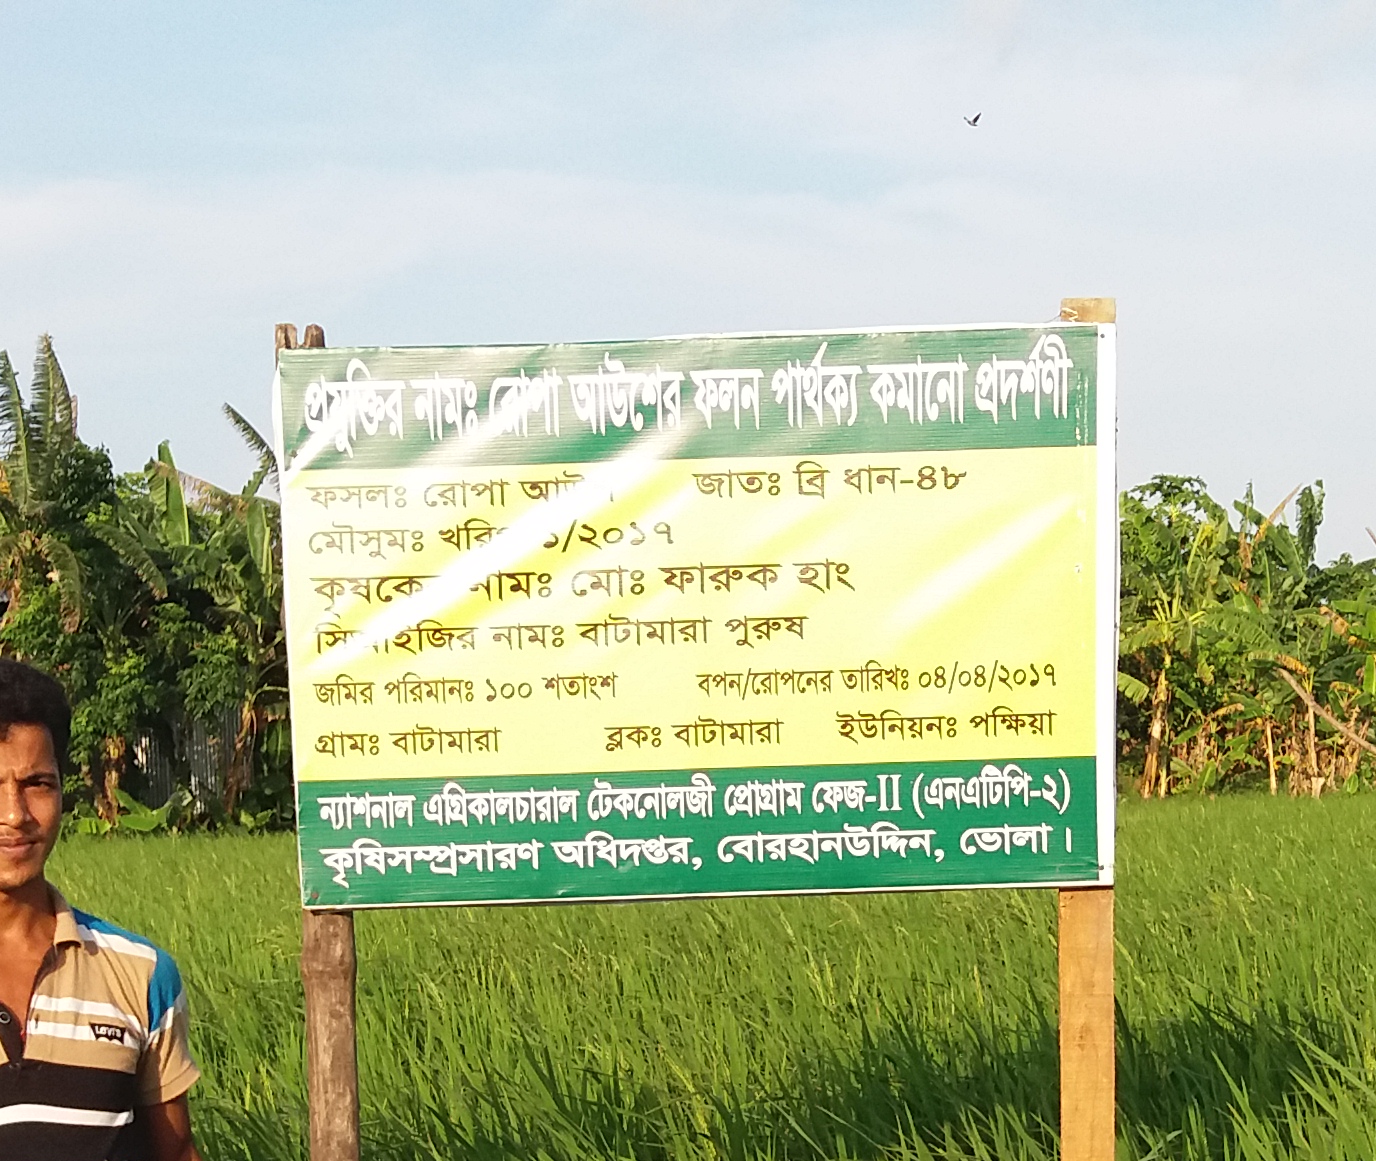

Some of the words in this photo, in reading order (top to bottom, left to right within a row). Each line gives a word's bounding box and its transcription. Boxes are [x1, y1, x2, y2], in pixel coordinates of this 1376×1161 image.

[305, 358, 406, 459] প্রযুক্তির
[410, 371, 478, 442] নামঃ
[489, 367, 564, 437] রোপা
[567, 352, 685, 436] আউশের
[690, 367, 764, 430] ফলন
[771, 342, 862, 428] পার্থক্য
[867, 353, 969, 425] কমানো
[424, 478, 511, 508] রোপা
[793, 461, 830, 499] ব্রি
[843, 465, 967, 494] ধান-৪৮
[309, 575, 446, 620] কৃষকে
[658, 562, 782, 594] ফারুক
[792, 558, 855, 594] হাং
[575, 613, 712, 647] বাটামারা
[725, 616, 809, 649] পুরুষ
[312, 674, 375, 706] জমির
[486, 678, 532, 702] ১০০
[541, 672, 619, 701] শতাংশ
[696, 667, 834, 700] বপন/রোপনের
[918, 659, 1057, 694] ০৪/০৪/২০১৭
[389, 723, 502, 755] বাটামারা
[671, 715, 784, 747] বাটামারা
[969, 706, 1057, 736] পক্ষিয়া
[317, 792, 416, 830] ন্যাশনাল
[423, 781, 581, 827] এগ্রিকালচারাল
[587, 772, 716, 821] টেকনোলজী
[724, 778, 806, 818] প্রোগ্রাম
[912, 763, 1071, 819] (এনএটিপি-২)
[319, 838, 545, 889] কৃষিসম্প্রসারণ
[551, 830, 703, 871] অধিদপ্তর,
[717, 821, 945, 863] বোরহানউদ্দিন,
